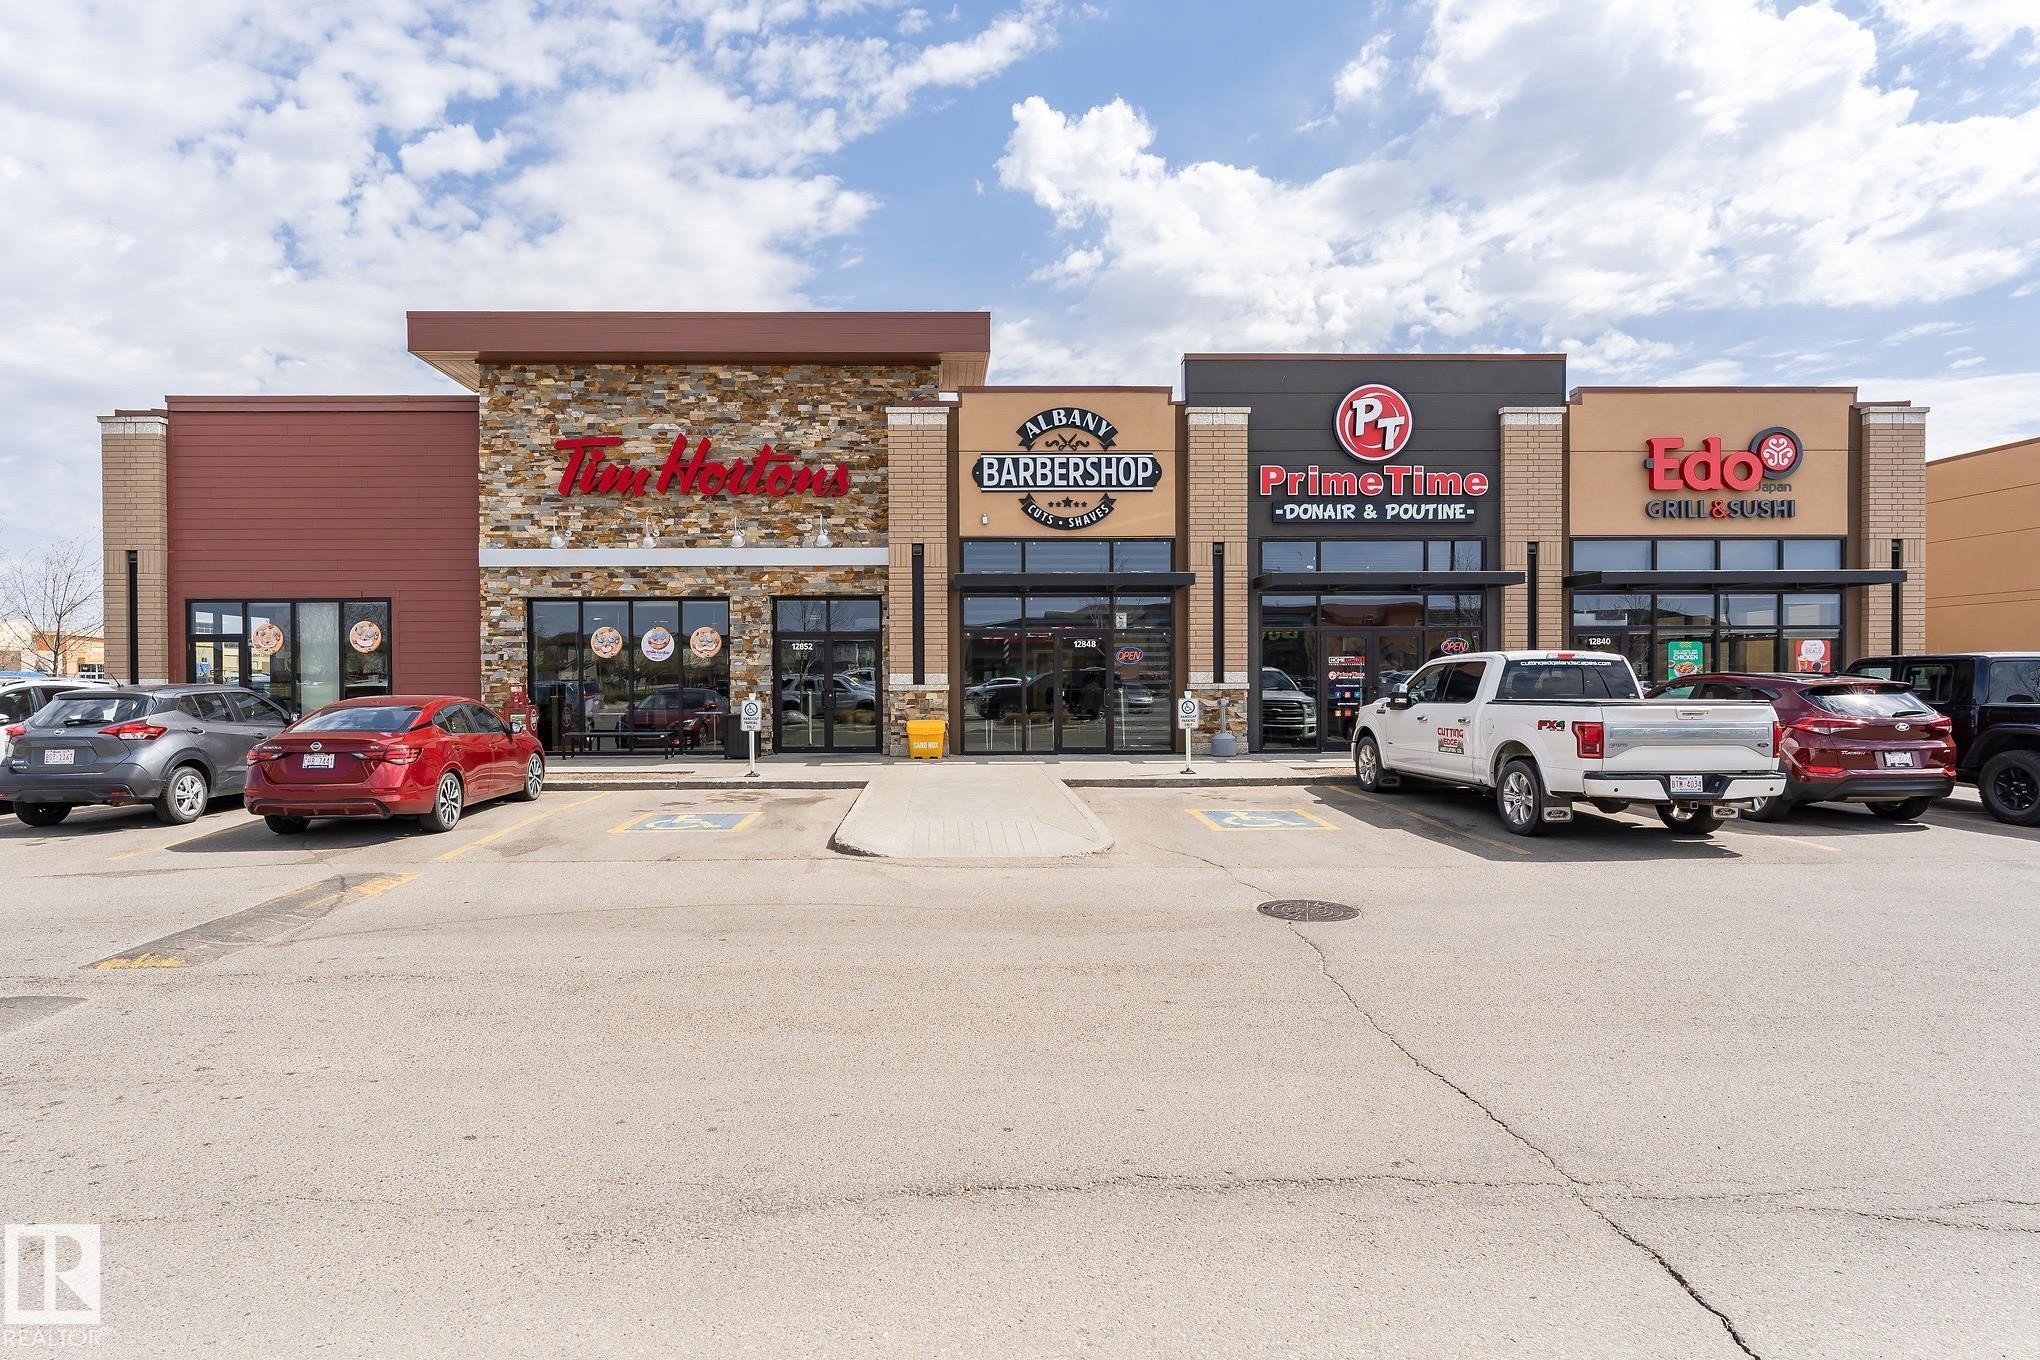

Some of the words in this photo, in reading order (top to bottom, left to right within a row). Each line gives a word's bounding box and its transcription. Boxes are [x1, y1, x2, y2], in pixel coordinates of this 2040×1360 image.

[1025, 409, 1113, 439] ALBANY
[1352, 398, 1405, 450] PT
[554, 436, 651, 497] Tim
[655, 433, 850, 497] Hortons
[1646, 437, 1764, 491] Edo
[983, 457, 1153, 487] BARBERSHOP
[1260, 465, 1489, 496] PrimeTime
[1027, 504, 1054, 525] CUTS
[1068, 504, 1109, 528] SHAVES
[1363, 504, 1378, 520] &
[1073, 640, 1097, 648] 12848
[1445, 641, 1467, 652] OPEN
[1588, 637, 1611, 645] 12840
[1118, 651, 1141, 660] OPEN
[1537, 719, 1566, 731] FX4
[1437, 727, 1464, 739] CUTTING
[913, 741, 928, 749] SAND
[928, 741, 939, 750] BOX
[1443, 738, 1458, 746] EDGE
